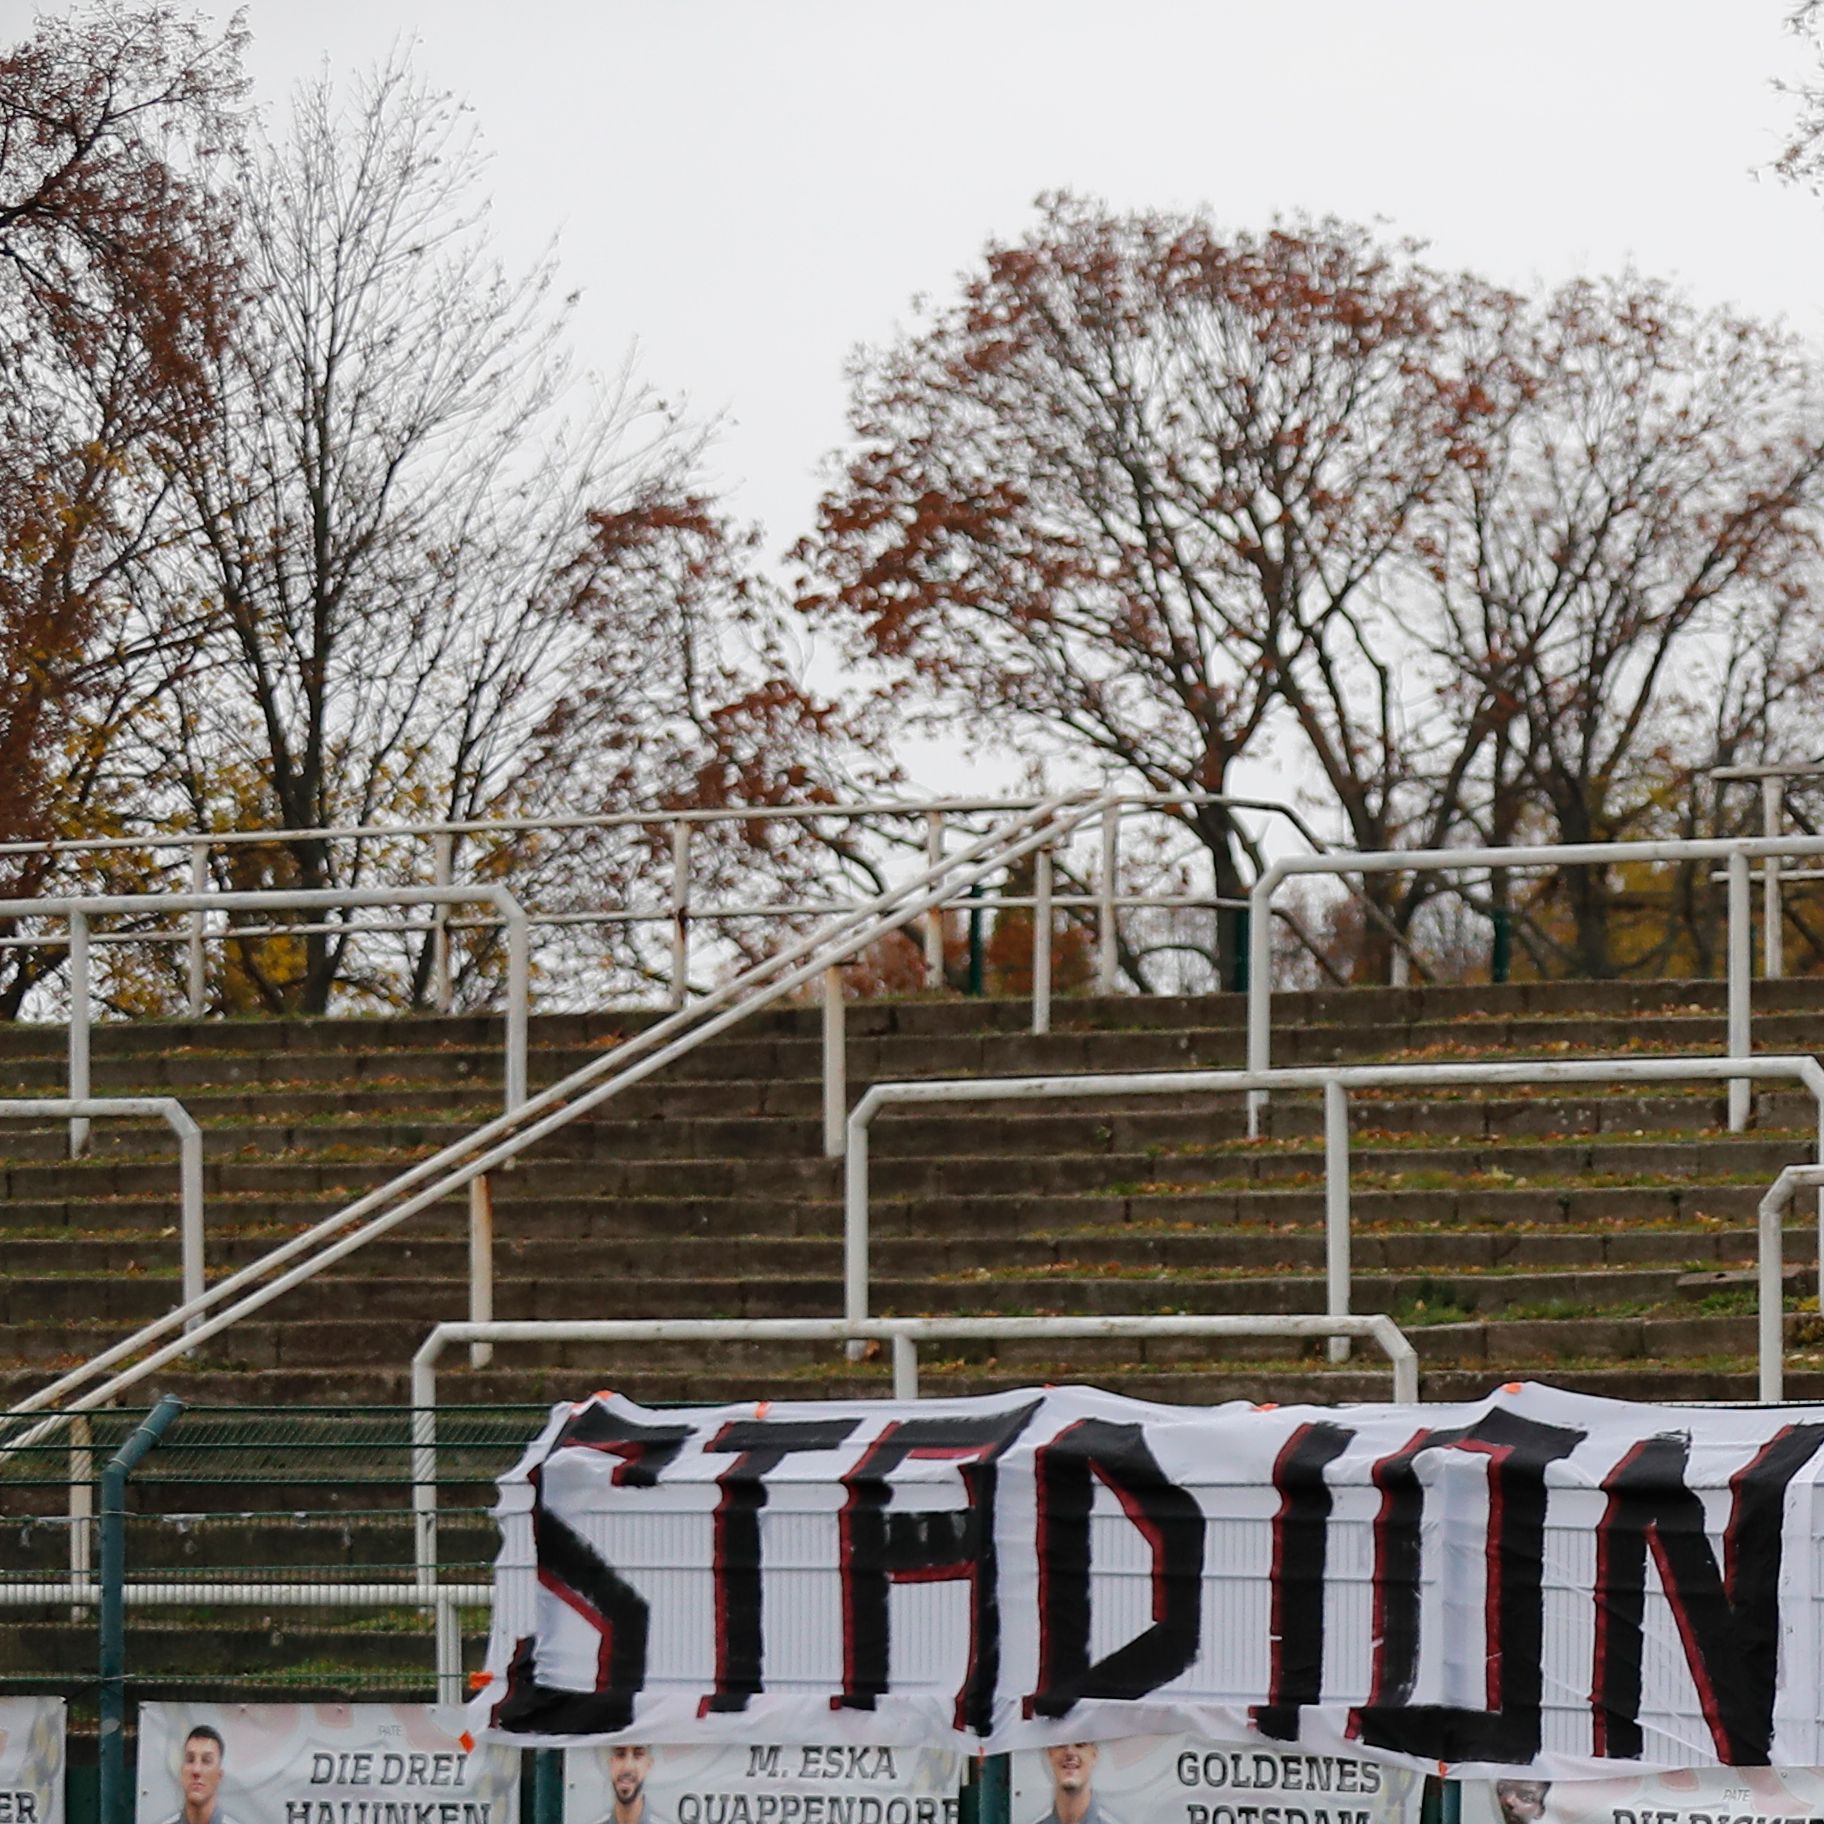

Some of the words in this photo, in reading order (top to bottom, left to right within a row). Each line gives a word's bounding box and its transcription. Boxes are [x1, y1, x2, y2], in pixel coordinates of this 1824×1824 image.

[311, 1753, 373, 1785] DIE
[381, 1752, 468, 1786] DREI
[746, 1744, 789, 1778] M.
[798, 1746, 898, 1780] ESKA
[1177, 1751, 1381, 1794] GOLDENES
